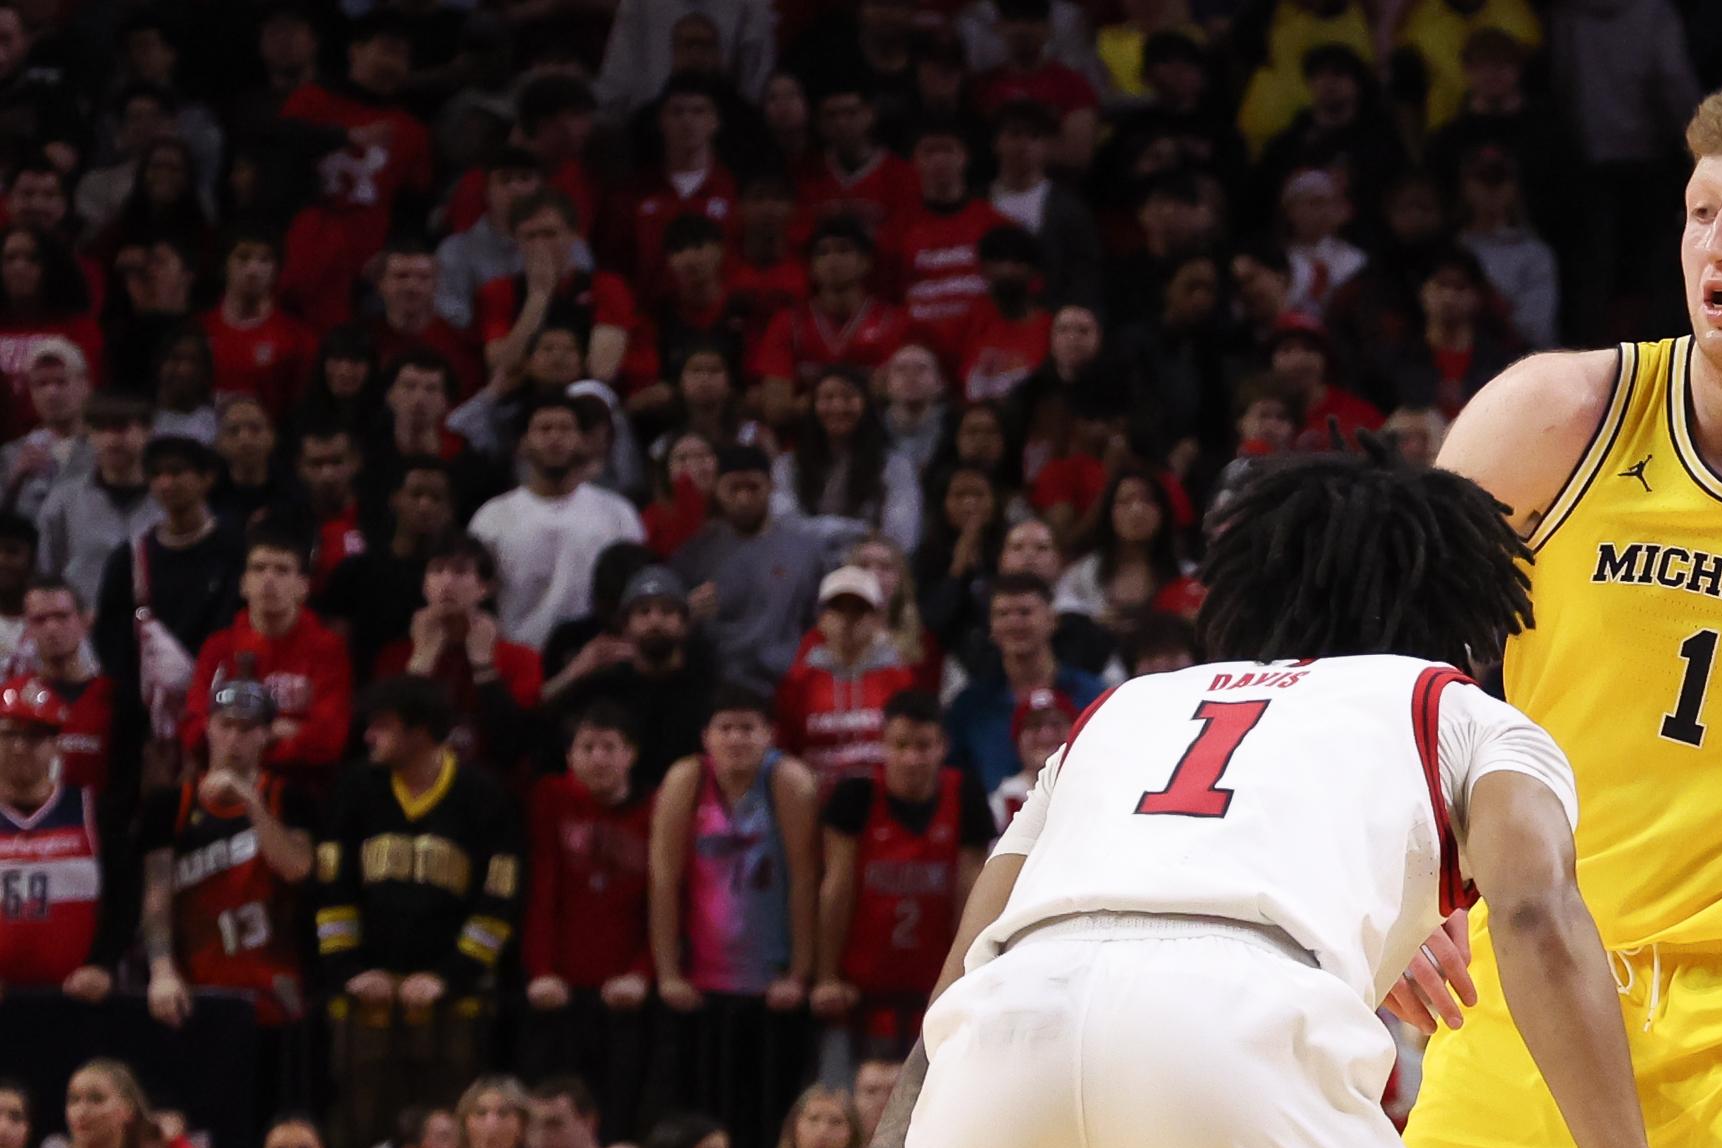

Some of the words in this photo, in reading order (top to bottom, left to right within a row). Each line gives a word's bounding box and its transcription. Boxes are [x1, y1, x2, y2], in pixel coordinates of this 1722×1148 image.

[1206, 671, 1311, 691] DAVIS
[1657, 627, 1721, 748] 1
[1132, 698, 1272, 819] 1
